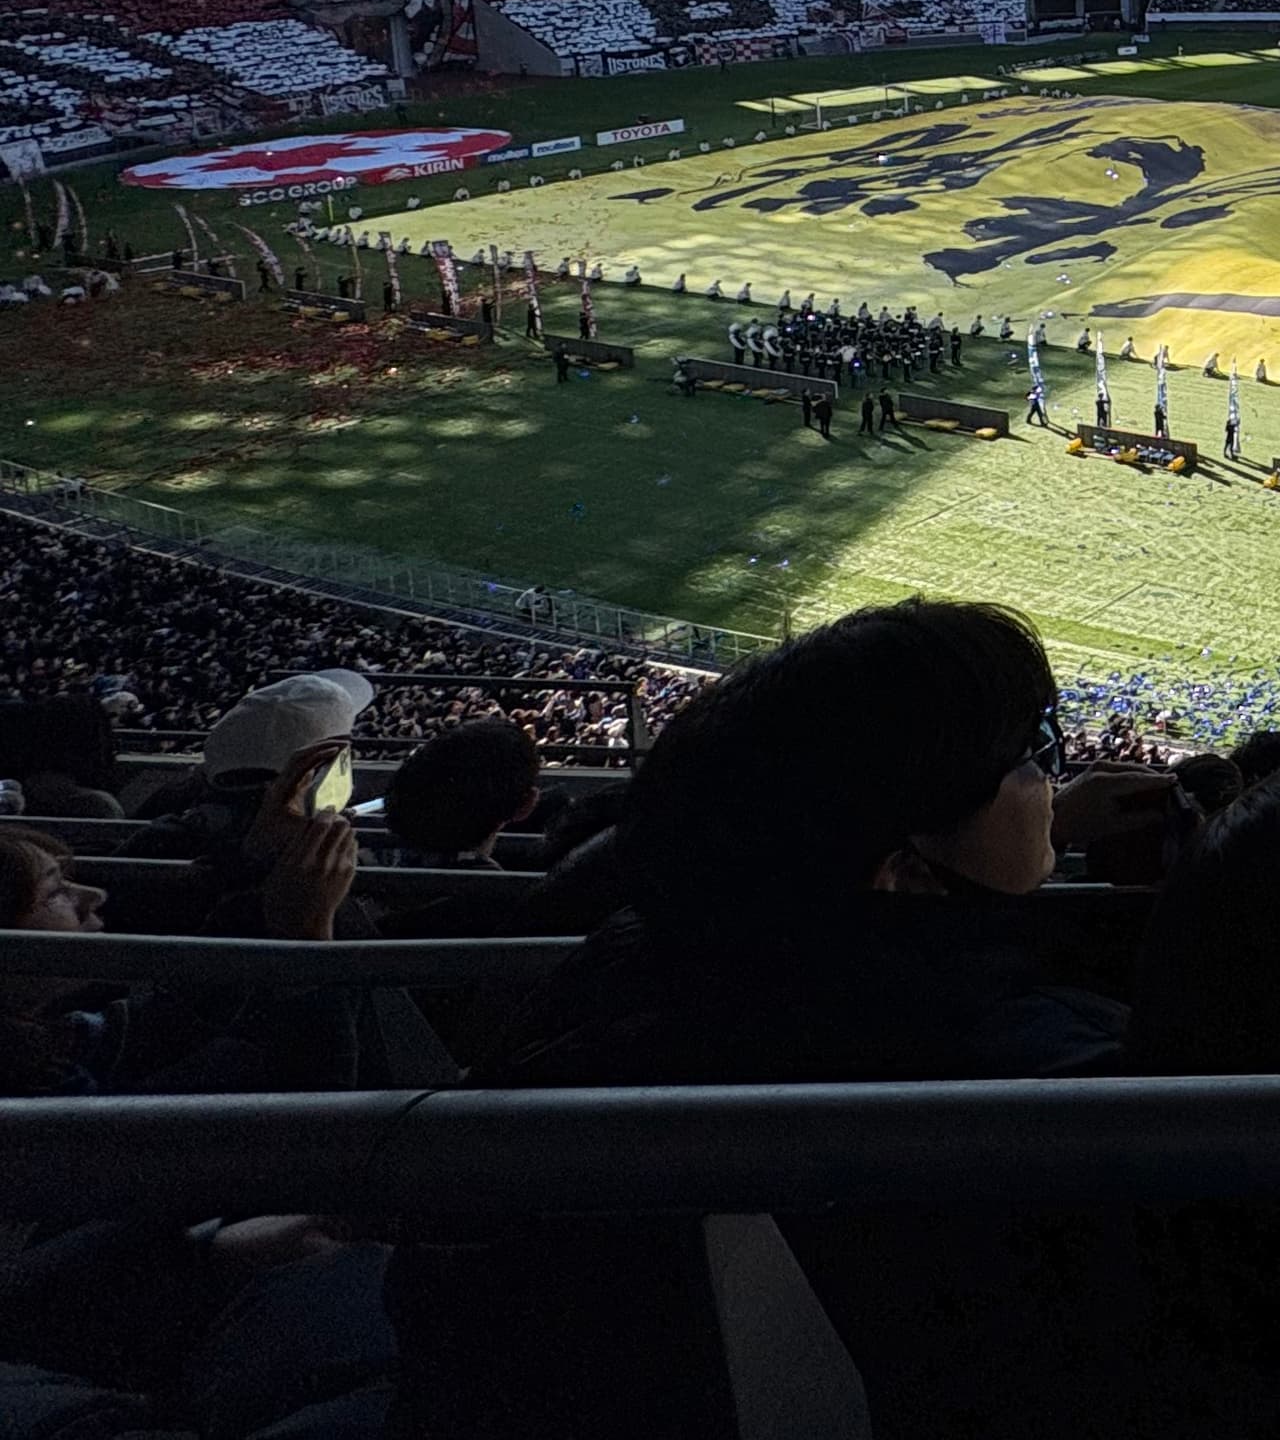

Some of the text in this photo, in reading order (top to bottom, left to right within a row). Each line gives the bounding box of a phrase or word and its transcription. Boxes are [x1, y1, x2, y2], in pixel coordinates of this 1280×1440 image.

[611, 122, 672, 142] TOYOTA
[413, 157, 465, 178] KIRIN
[288, 175, 358, 199] GROUP
